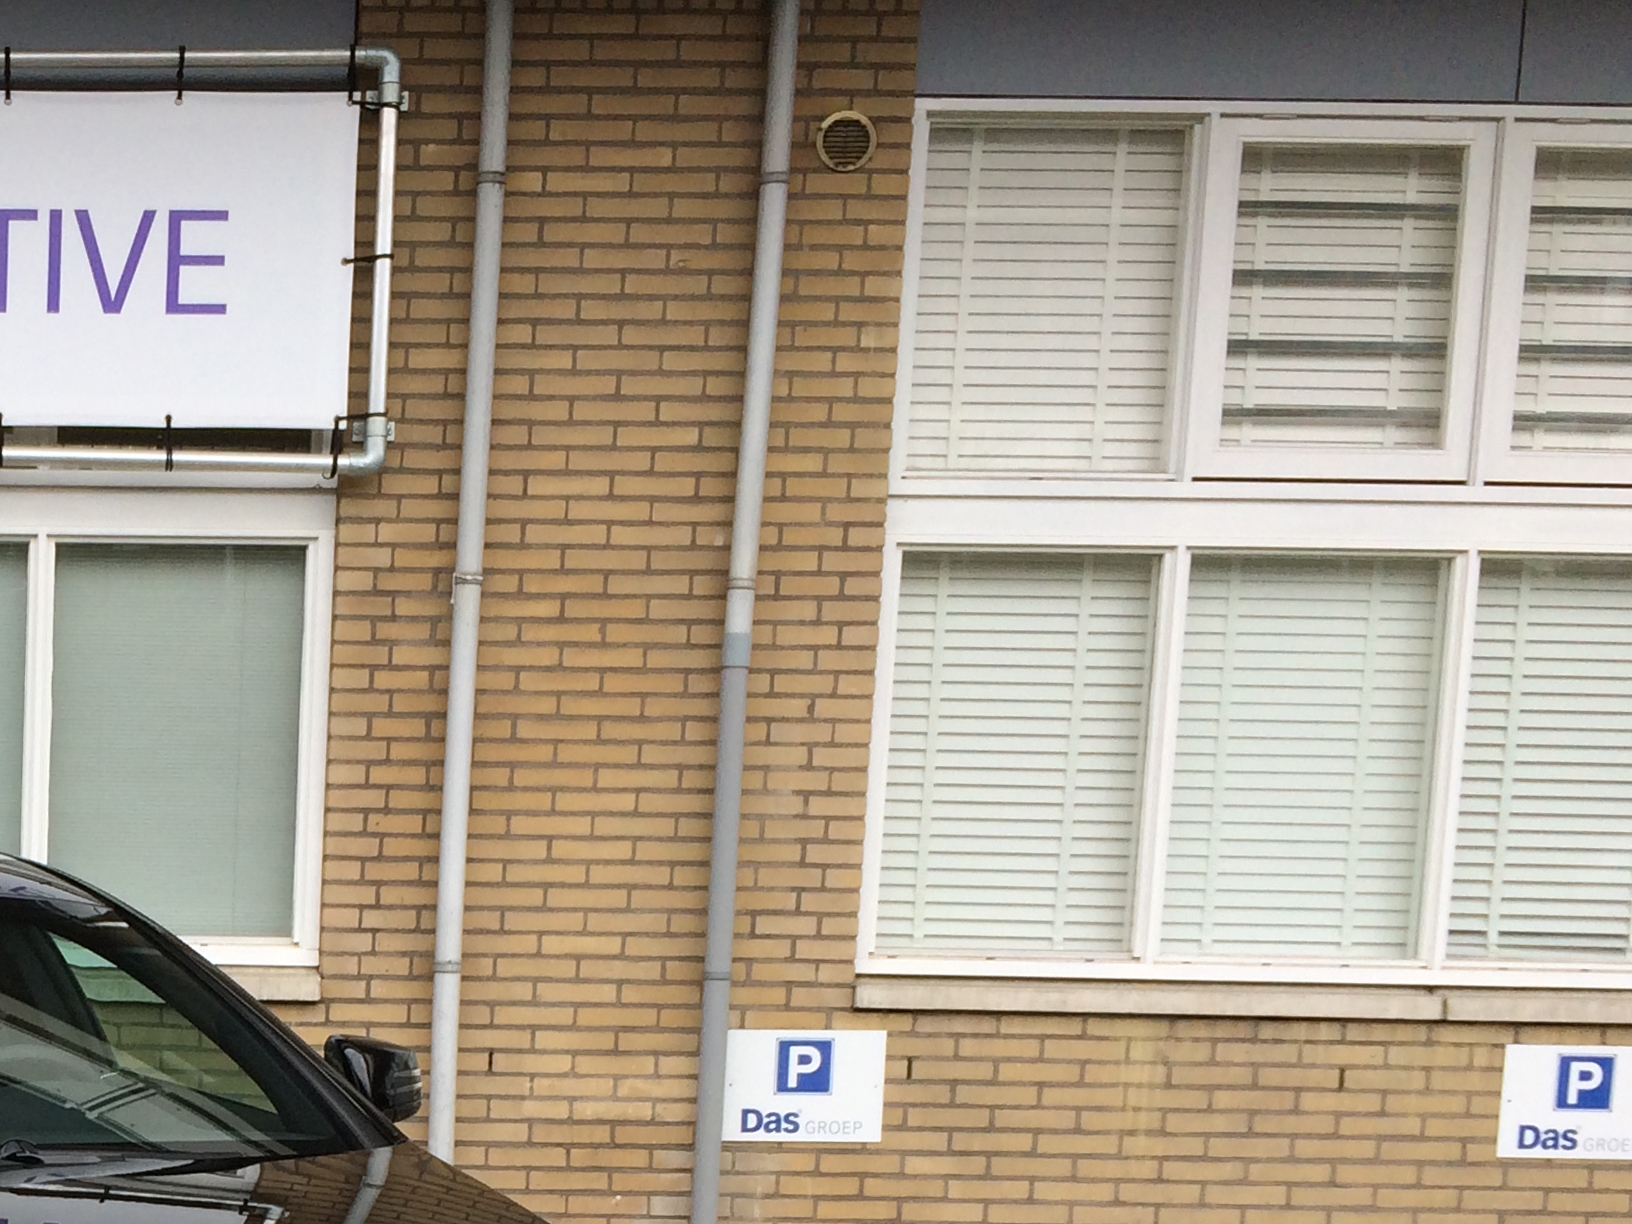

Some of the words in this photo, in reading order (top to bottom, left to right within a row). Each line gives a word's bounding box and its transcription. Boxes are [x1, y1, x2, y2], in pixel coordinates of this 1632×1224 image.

[787, 1045, 822, 1088] P
[1566, 1060, 1604, 1105] P
[740, 1108, 800, 1134] Das
[805, 1120, 863, 1135] GROEP
[1517, 1124, 1578, 1150] Das
[1583, 1136, 1632, 1152] GROE
